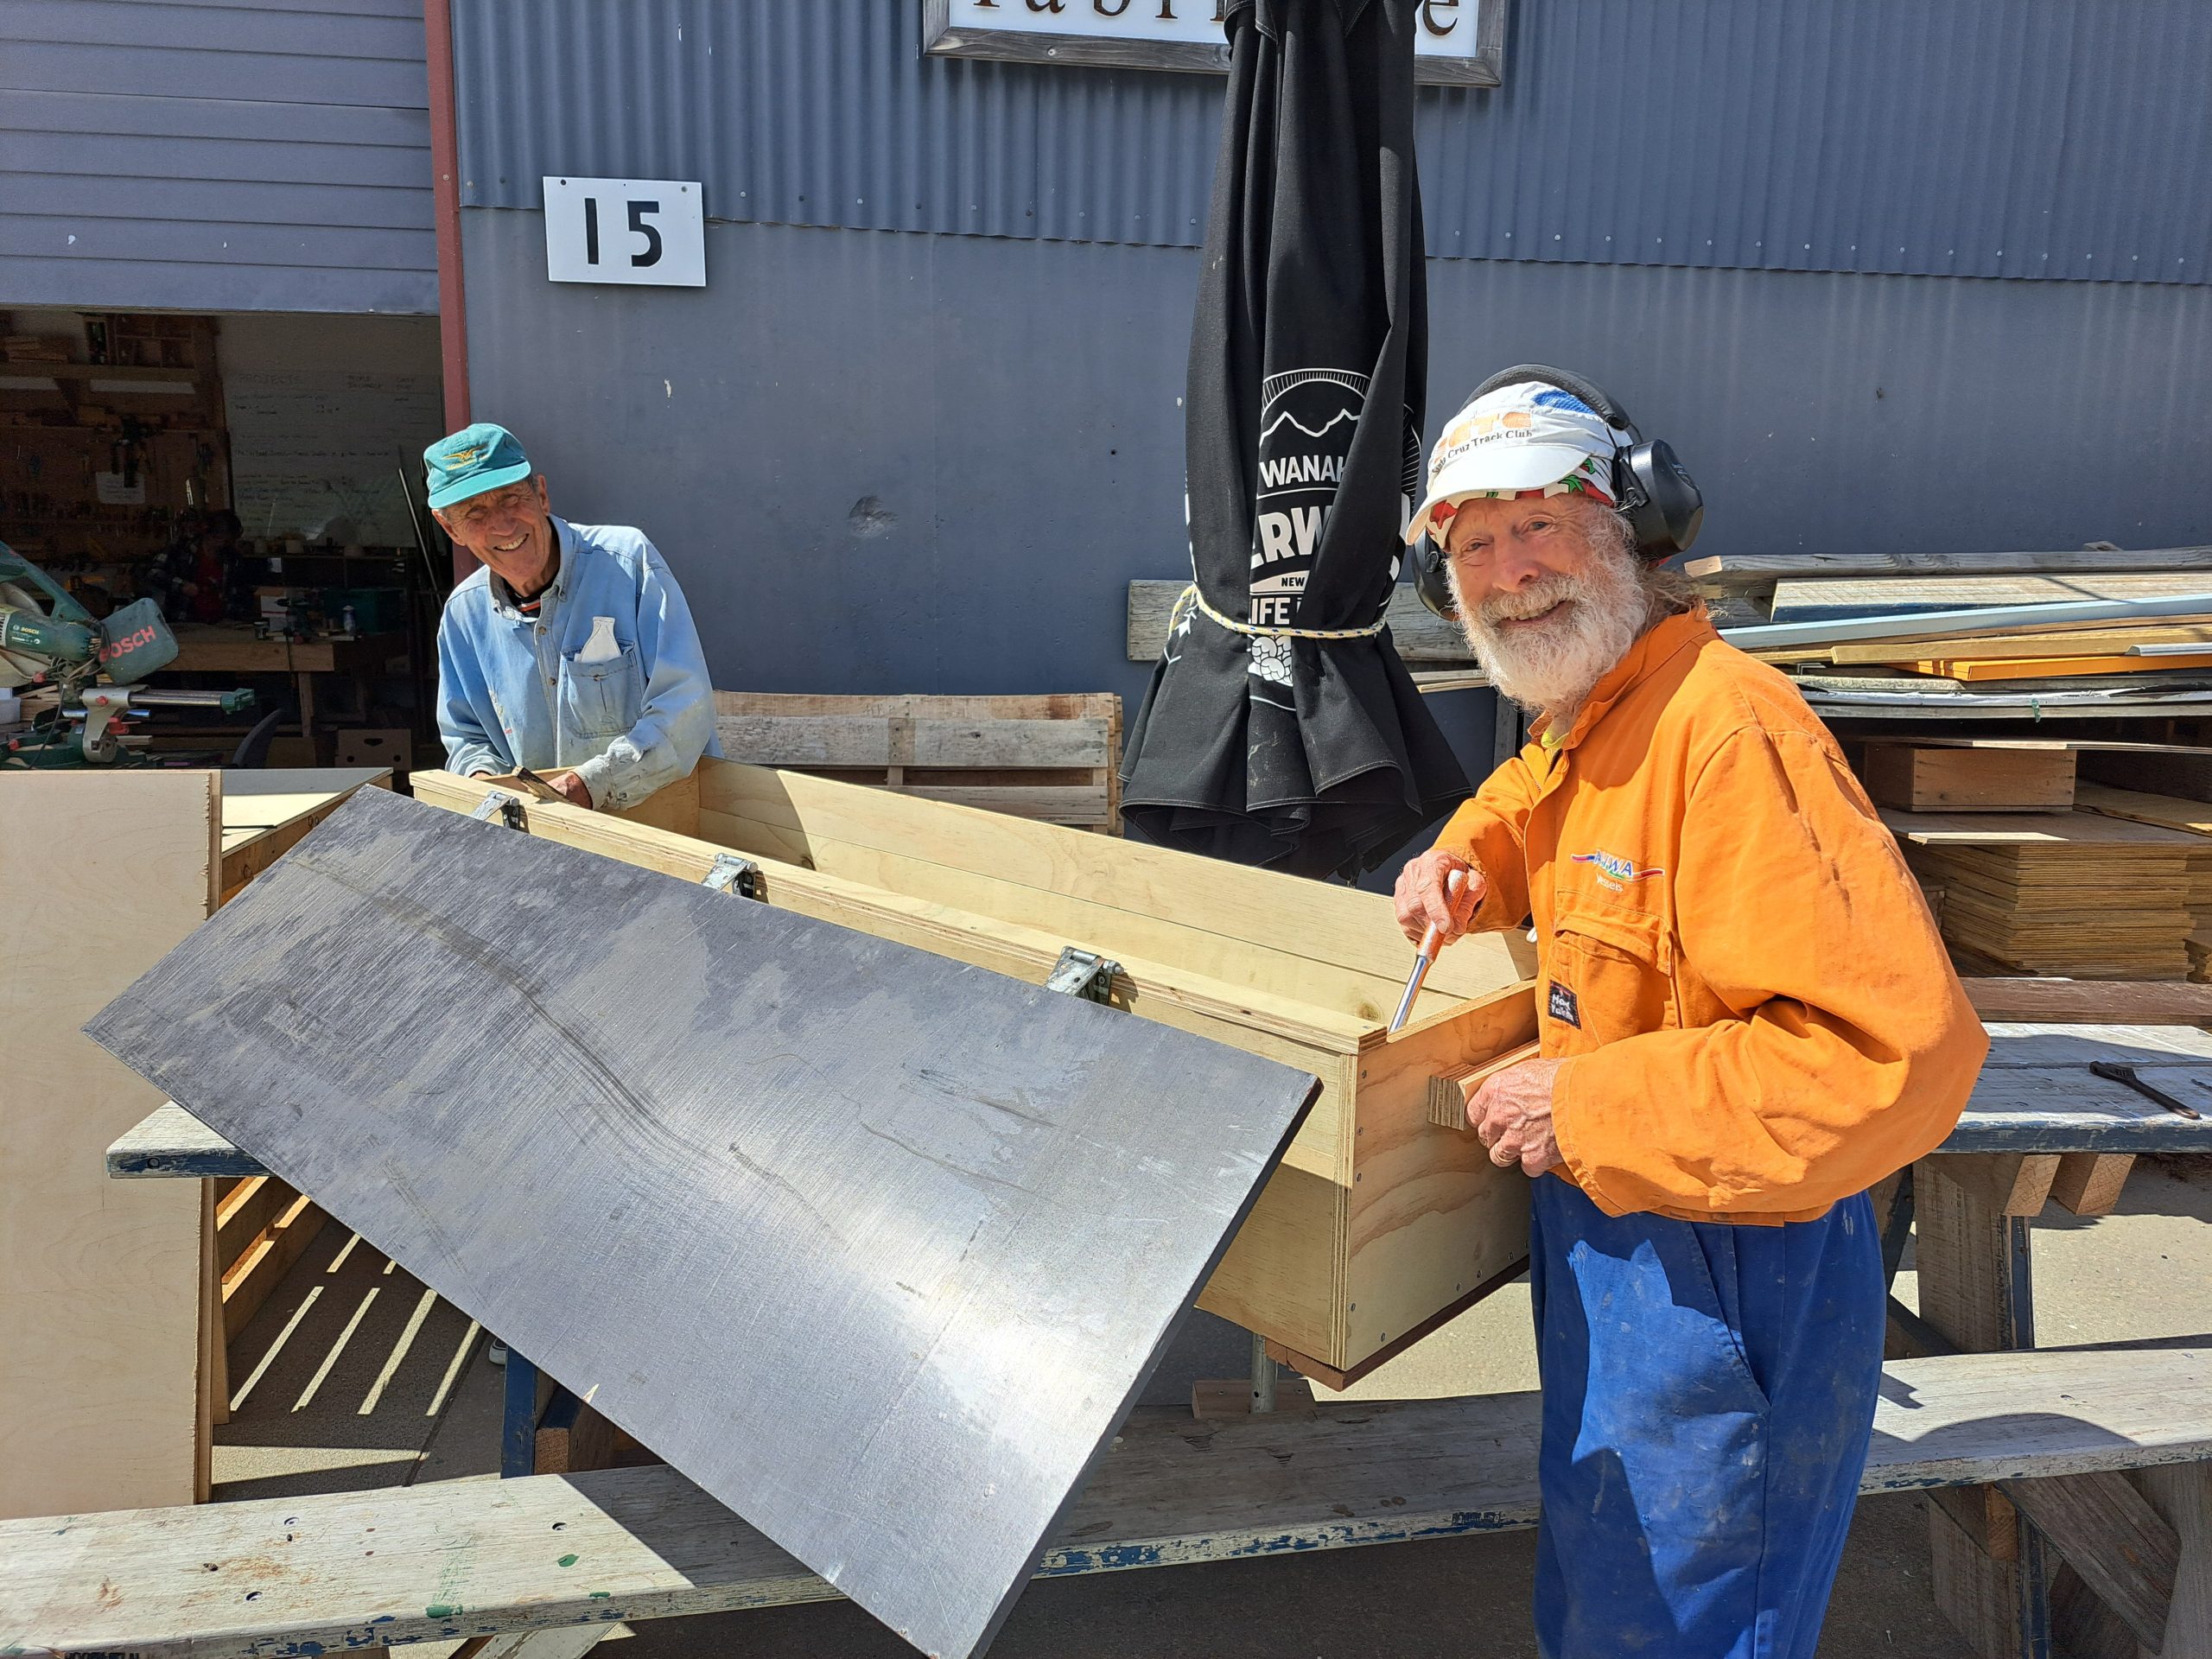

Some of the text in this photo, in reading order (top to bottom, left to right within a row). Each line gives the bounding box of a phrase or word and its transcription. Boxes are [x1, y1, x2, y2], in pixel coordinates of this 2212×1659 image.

[584, 198, 663, 267] 15
[1447, 443, 1470, 459] Cruz
[1471, 432, 1503, 447] Track
[1505, 429, 1533, 439] Club
[1249, 505, 1332, 570] RW
[1281, 577, 1305, 588] NEW
[1248, 597, 1291, 625] IFE
